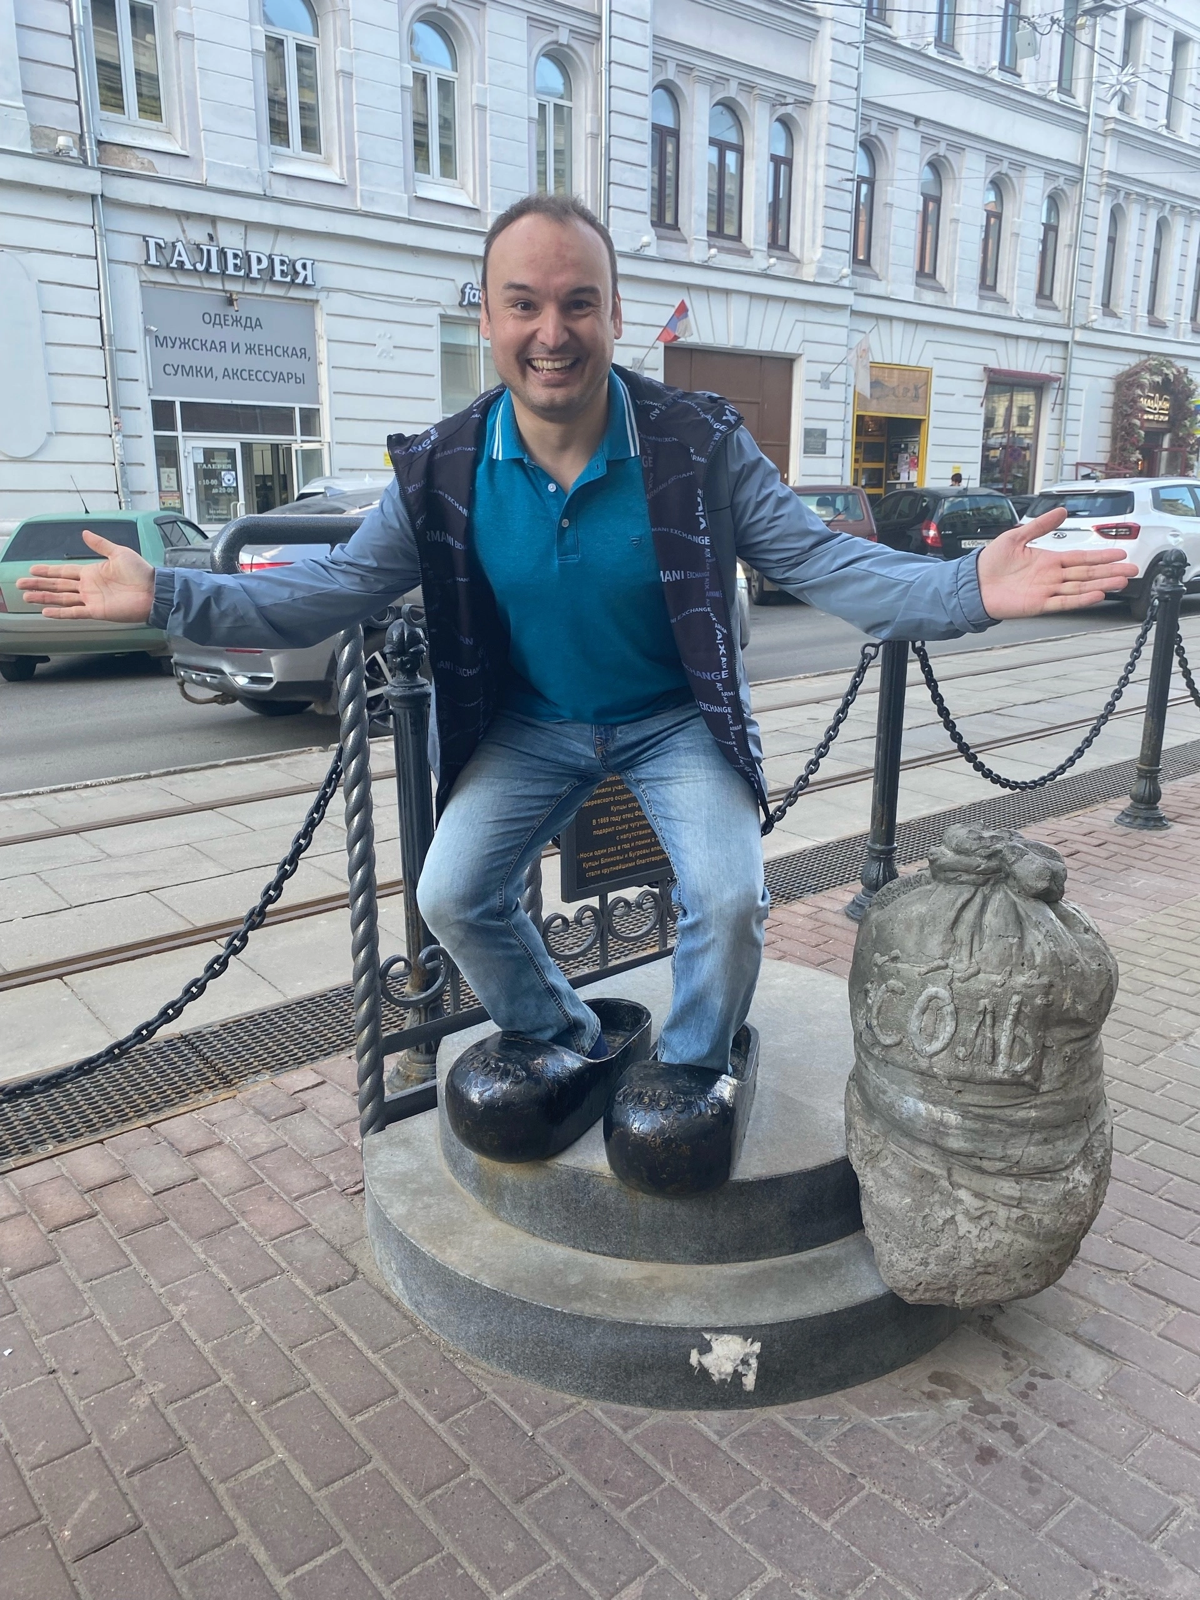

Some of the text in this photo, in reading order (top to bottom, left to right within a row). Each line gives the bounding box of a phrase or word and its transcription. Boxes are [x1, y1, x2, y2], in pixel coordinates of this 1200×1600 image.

[145, 237, 315, 285] ГАЛЕРЕЯ
[463, 283, 482, 305] fa
[202, 312, 263, 331] ОДЕЖДА
[154, 335, 311, 362] МУЖСКАЯ И ЖЕНСКАЯ,
[163, 363, 305, 385] СУМКИ, АКСЕССУАРЫ
[610, 804, 628, 812] Купцы
[610, 815, 621, 823] году
[593, 827, 615, 836] подарил
[582, 861, 600, 869] Купцы
[600, 854, 624, 864] Блиновы
[628, 847, 651, 858] Бугровы
[594, 848, 607, 856] один
[607, 845, 617, 853] раз
[621, 842, 631, 850] год
[585, 869, 601, 878] стали
[870, 980, 1036, 1075] СОЛЬ
